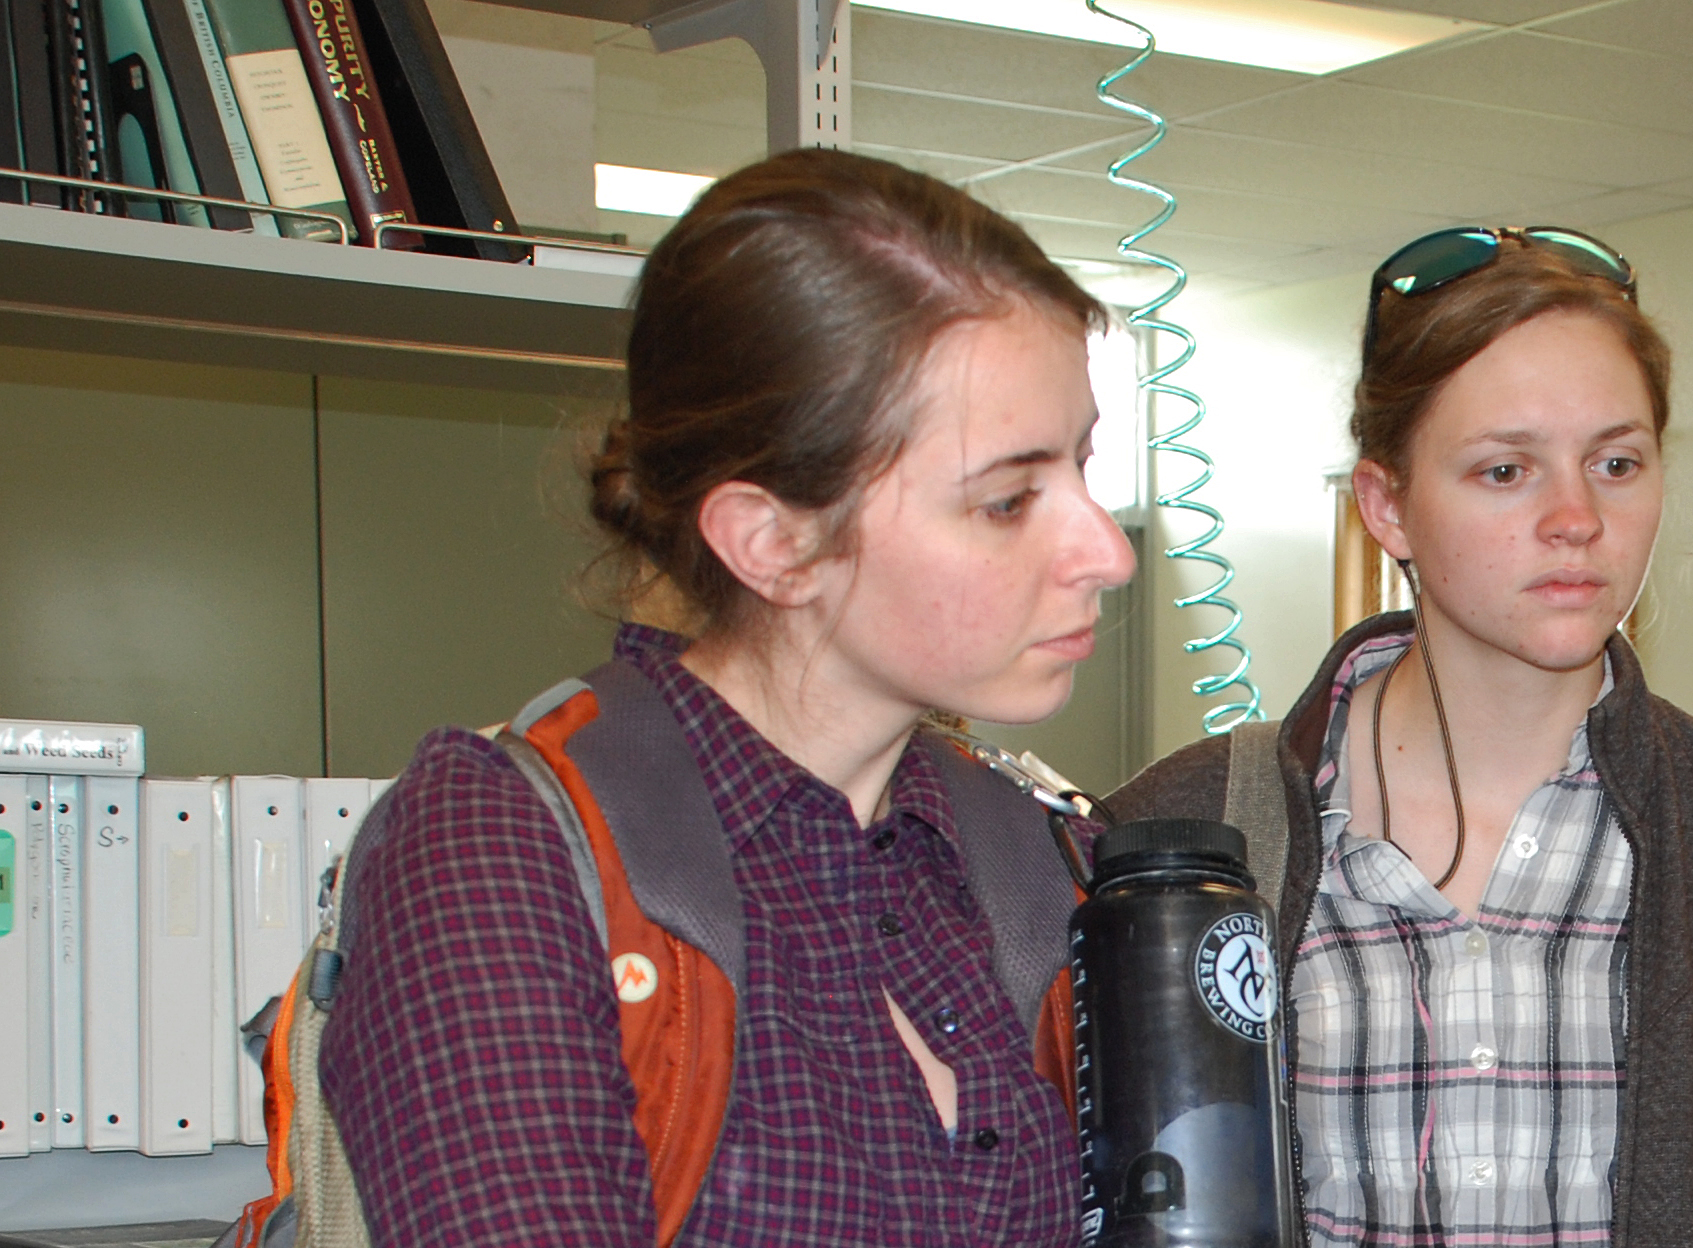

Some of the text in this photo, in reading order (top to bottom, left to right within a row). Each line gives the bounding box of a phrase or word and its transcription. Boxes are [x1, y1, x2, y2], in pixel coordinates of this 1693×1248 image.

[211, 60, 236, 119] COLUMBIA
[309, 0, 351, 101] ONOMY
[330, 0, 371, 99] PURITY
[24, 743, 67, 758] Weed
[72, 745, 114, 759] Seeds
[1200, 947, 1254, 1036] BREWING
